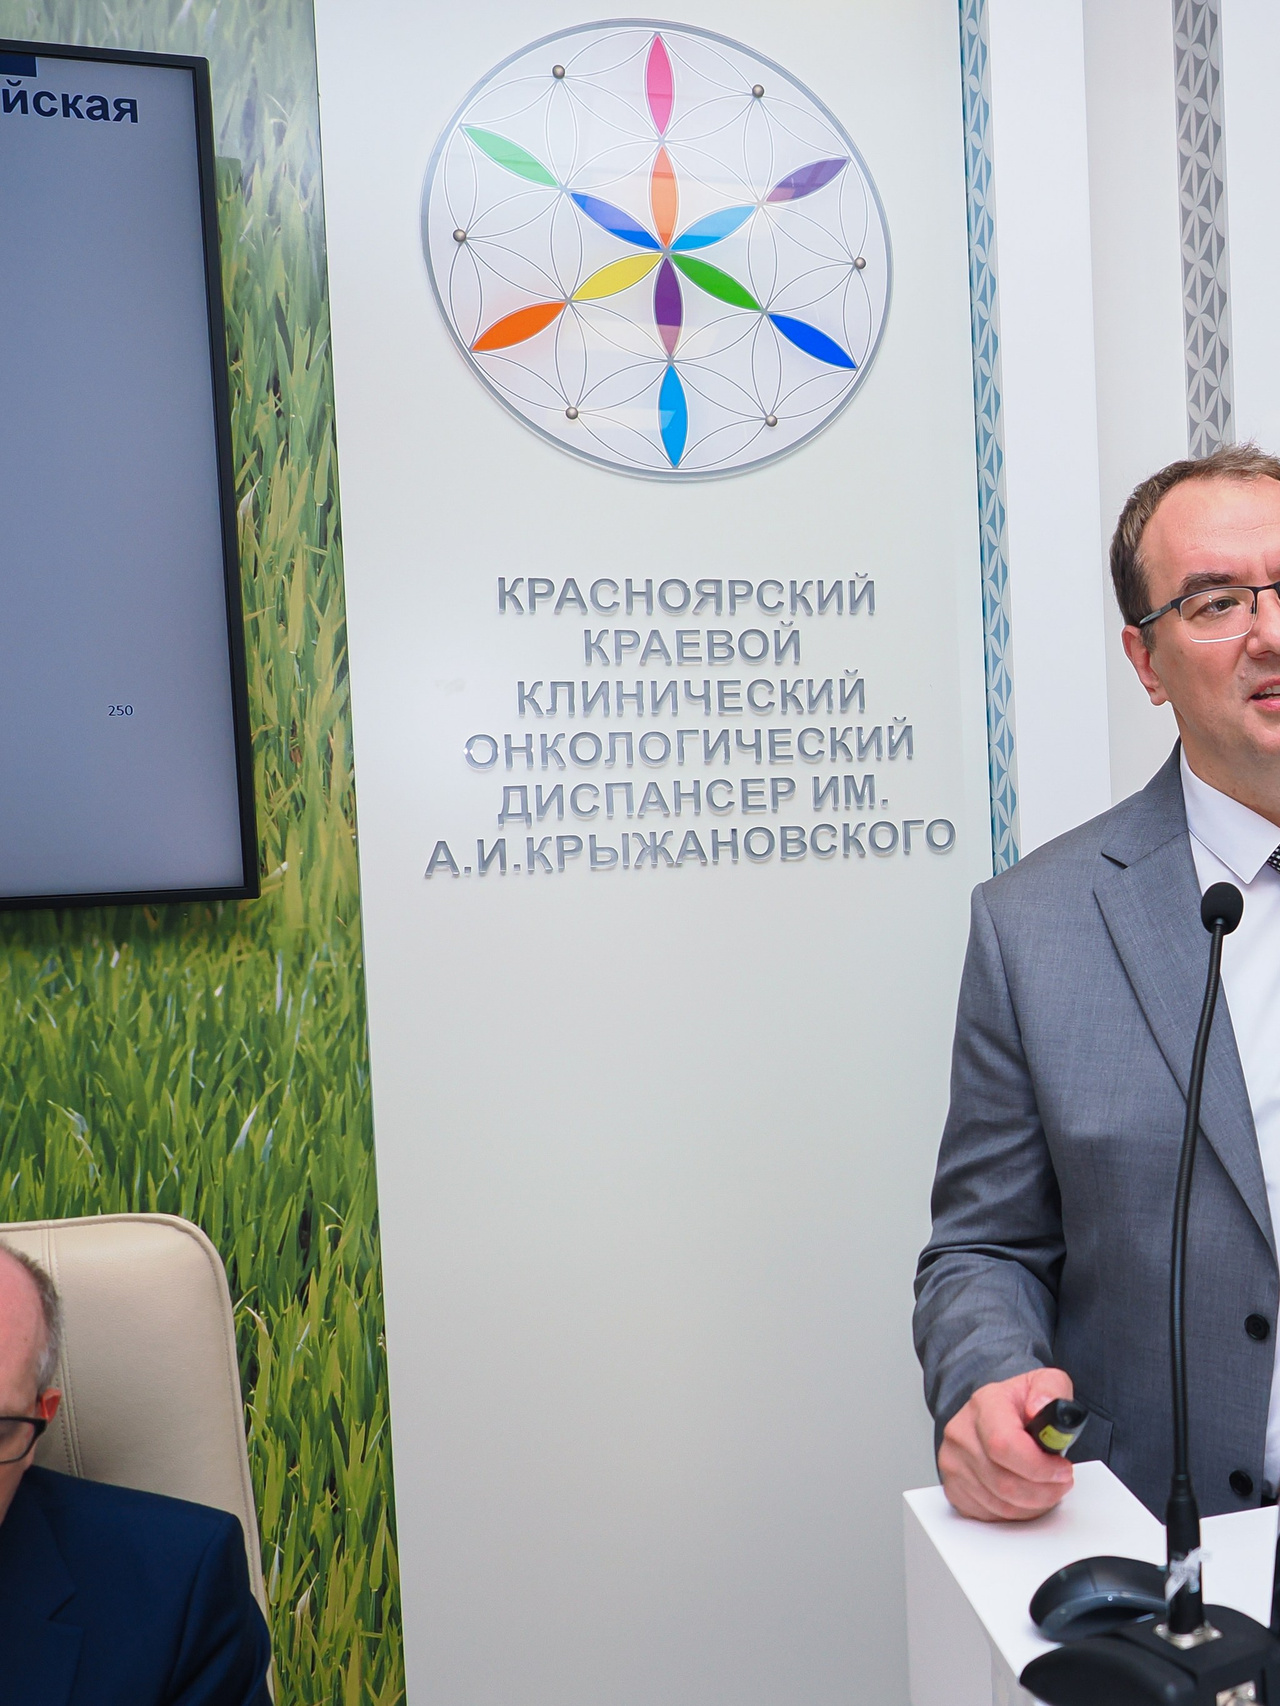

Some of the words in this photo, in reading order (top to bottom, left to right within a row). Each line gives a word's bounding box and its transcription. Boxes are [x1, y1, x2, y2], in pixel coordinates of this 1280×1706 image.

[2, 79, 138, 123] йская
[497, 572, 876, 615] КРАСНОЯРСКИЙ
[584, 620, 802, 665] КРАЕВОЙ
[107, 704, 134, 717] 250
[516, 668, 866, 717] КЛИНИЧЕСКИЙ
[463, 716, 915, 770] ОНКОЛОГИЧЕСКИЙ
[497, 776, 796, 829] ДИСПАНСЕР
[812, 774, 889, 811] ИМ.
[424, 817, 956, 878] А.И.КРЫЖАНОВСКОГО
